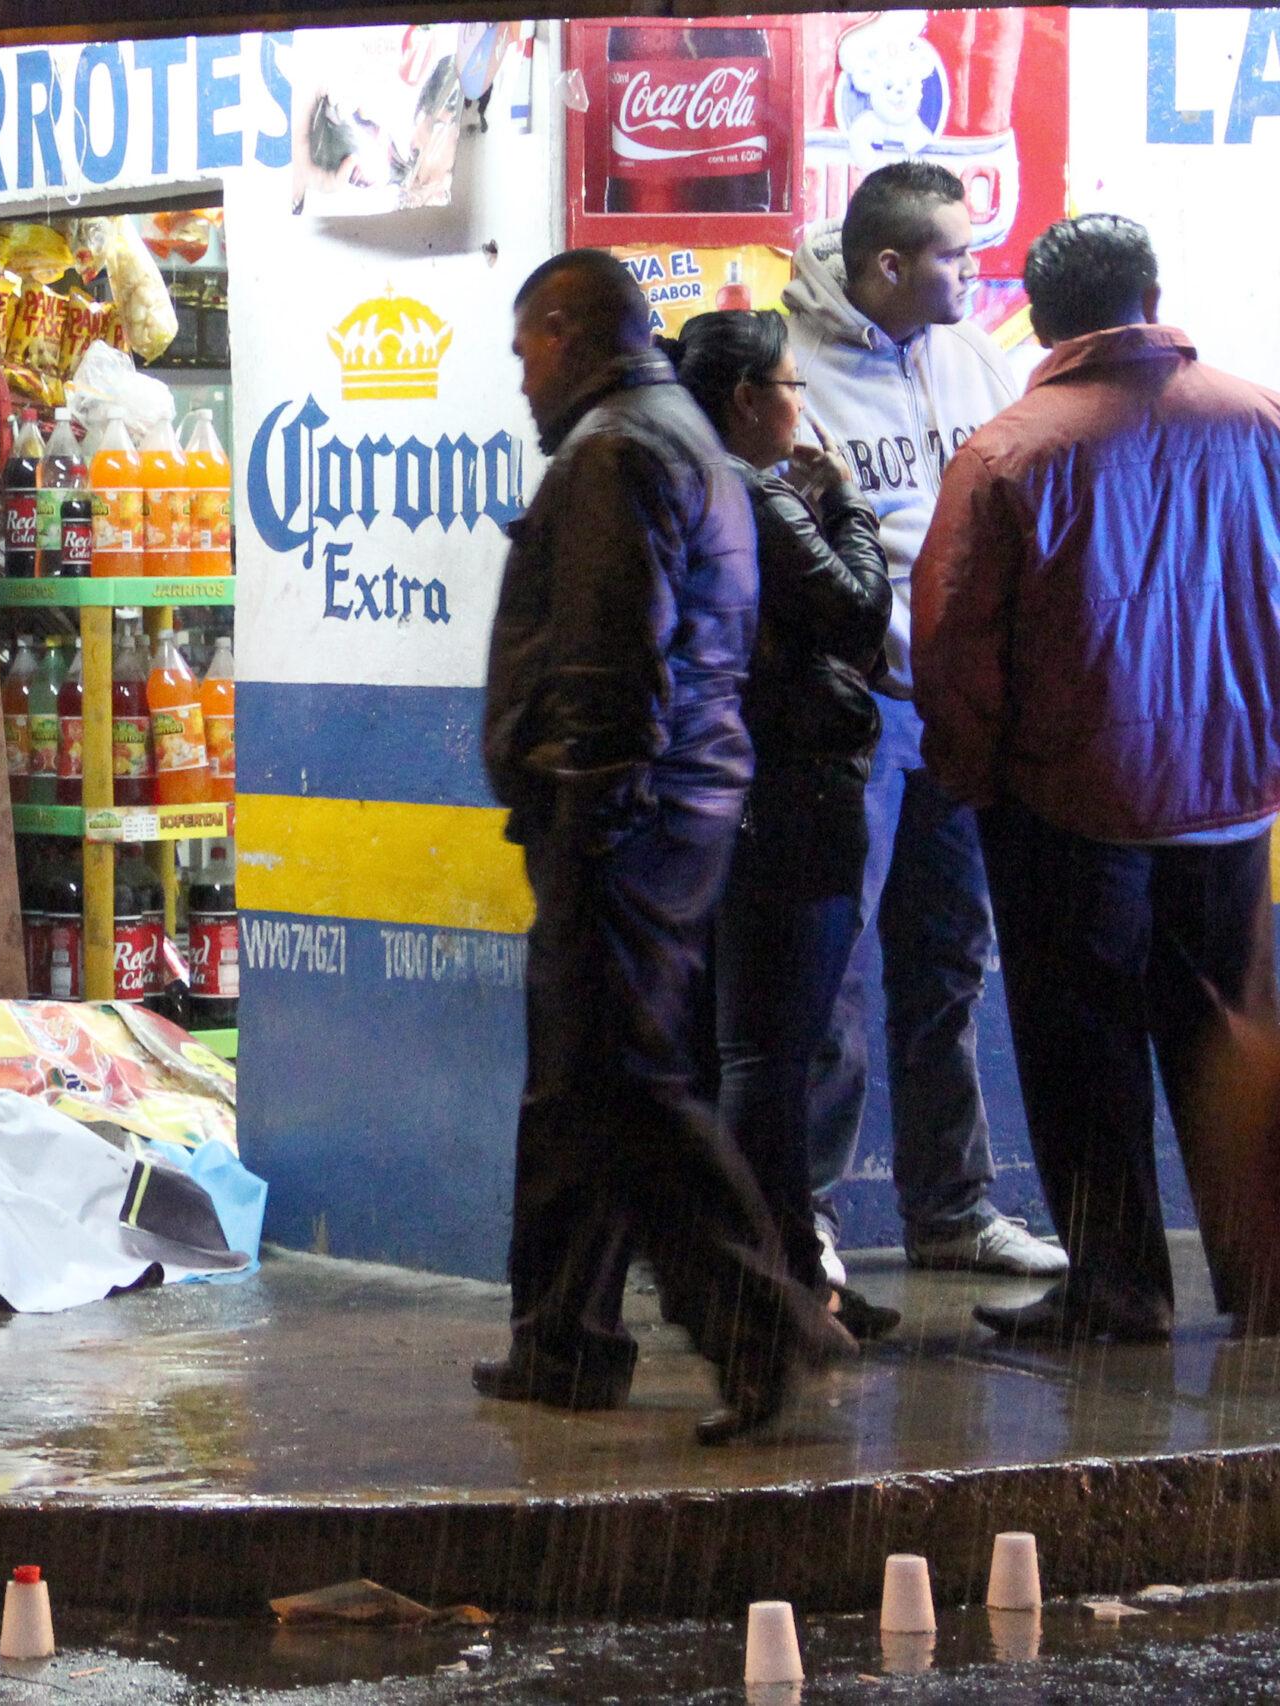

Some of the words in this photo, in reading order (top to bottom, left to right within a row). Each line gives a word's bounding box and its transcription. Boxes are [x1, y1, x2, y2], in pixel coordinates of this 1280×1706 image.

[620, 67, 759, 133] Coca-Cola
[671, 252, 700, 277] EL
[650, 283, 701, 302] SABOR
[247, 392, 529, 570] Corona
[6, 508, 37, 530] Red
[322, 542, 451, 625] Extra
